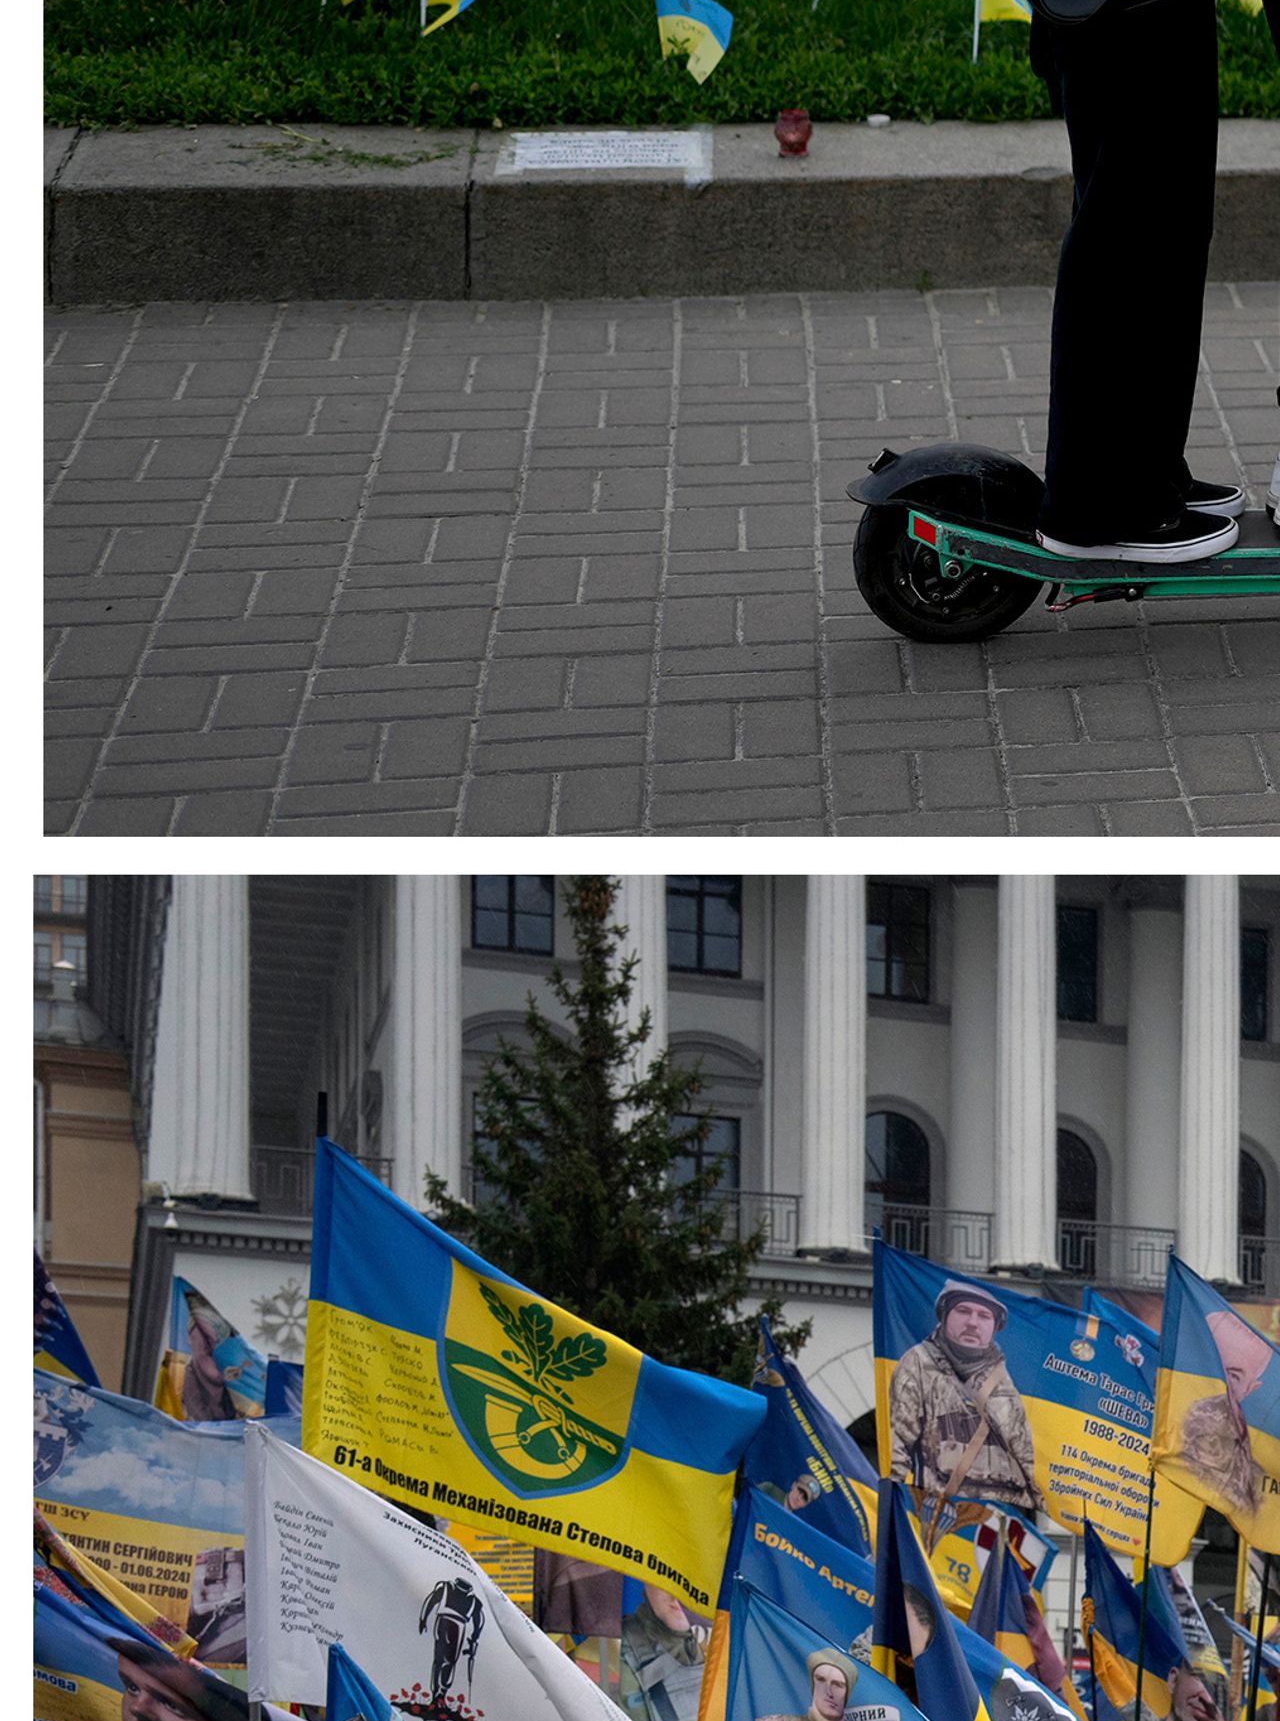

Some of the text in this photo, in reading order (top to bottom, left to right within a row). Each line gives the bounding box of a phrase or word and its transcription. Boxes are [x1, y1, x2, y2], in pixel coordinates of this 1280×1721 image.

[1043, 1353, 1098, 1385] Аштема
[1100, 1373, 1135, 1402] Тарас
[1084, 1419, 1150, 1456] 1988-2024
[1061, 1444, 1079, 1460] 114
[1080, 1449, 1118, 1475] Окрема
[1049, 1462, 1120, 1494] територіальної
[1049, 1479, 1093, 1502] Збройних
[1094, 1492, 1113, 1509] Сил
[60, 1506, 90, 1521] ЗСУ
[334, 1445, 372, 1474] 61-а
[375, 1452, 428, 1498] Окрема
[432, 1480, 563, 1537] Механізована
[567, 1522, 644, 1566] Степова
[648, 1554, 710, 1607] бригада
[113, 1542, 193, 1567] СЕРГІЙОВИЧ
[945, 1556, 972, 1584] 78
[148, 1584, 189, 1600] ГЕРОЮ
